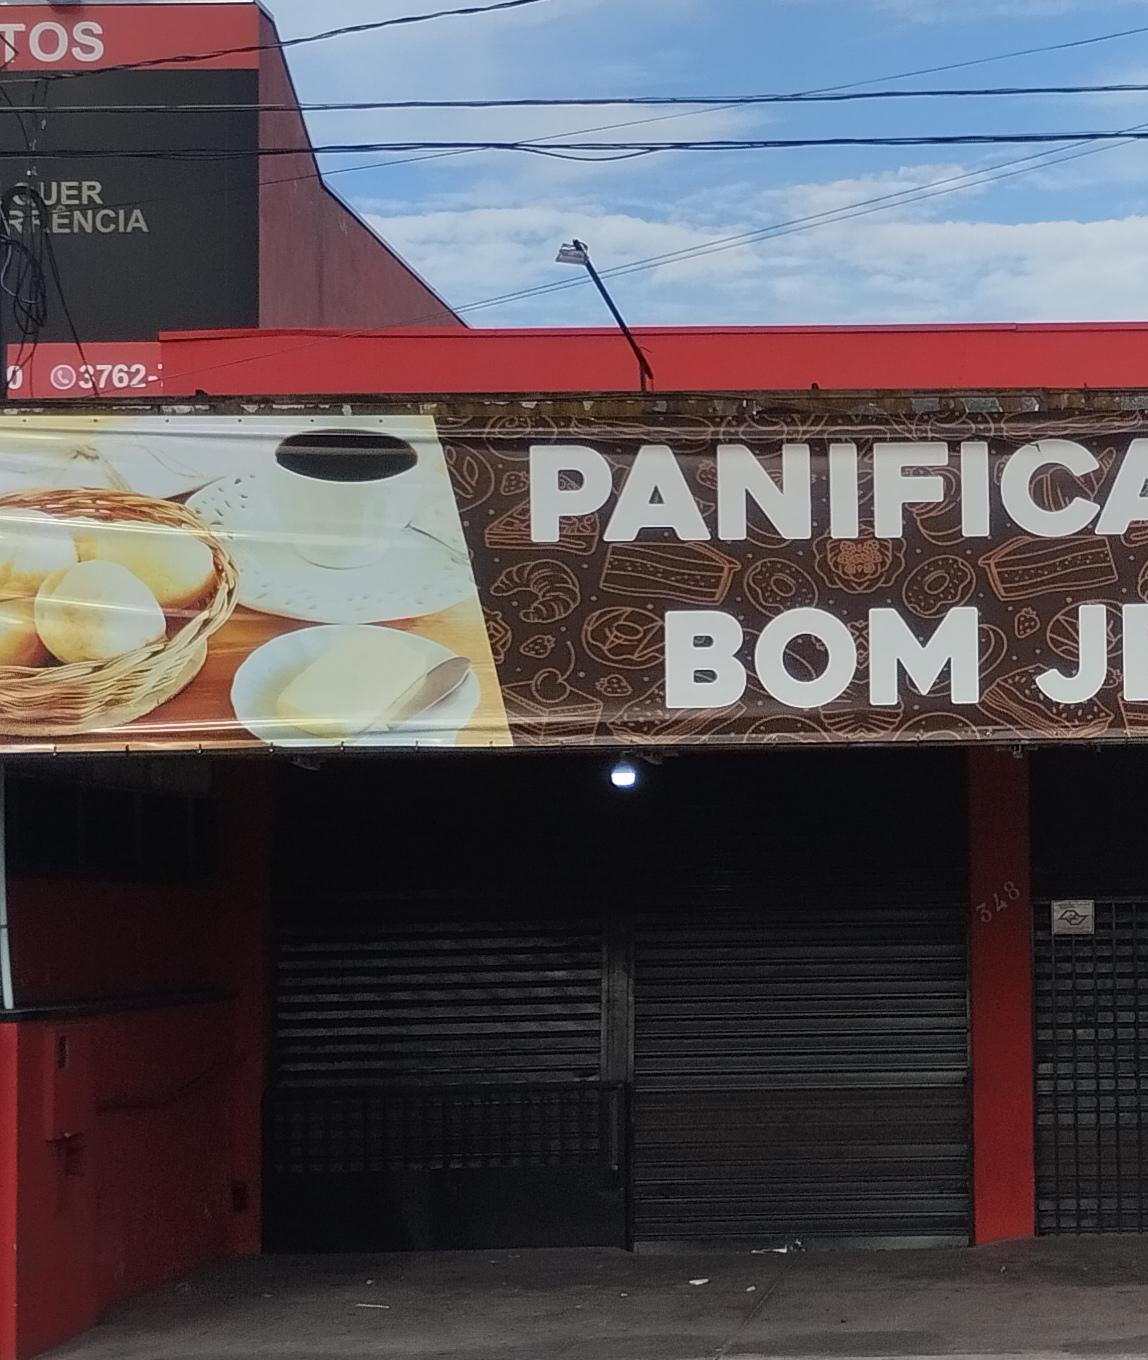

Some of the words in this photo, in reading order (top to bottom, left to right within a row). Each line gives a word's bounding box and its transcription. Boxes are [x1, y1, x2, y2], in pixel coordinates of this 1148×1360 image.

[0, 21, 104, 63] TOS
[79, 363, 164, 389] 3762-
[664, 603, 980, 709] BOM
[976, 880, 1020, 922] 348
